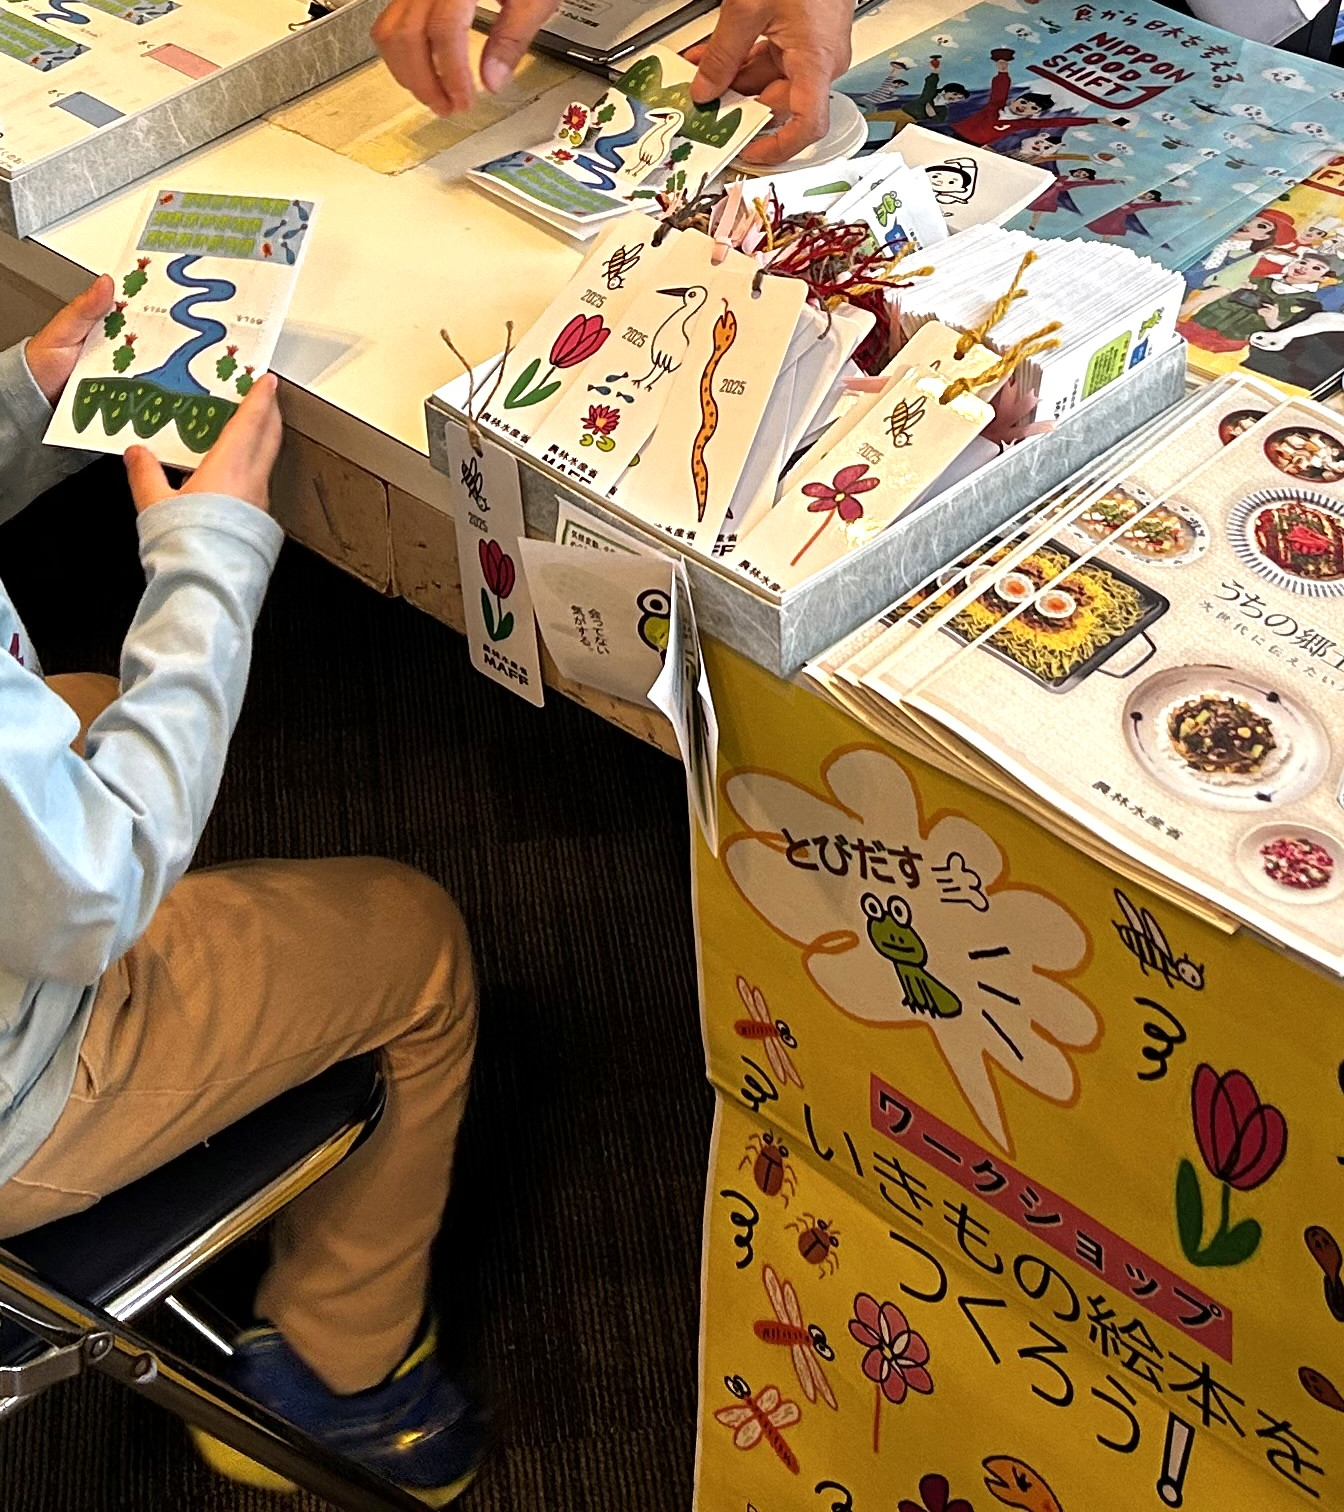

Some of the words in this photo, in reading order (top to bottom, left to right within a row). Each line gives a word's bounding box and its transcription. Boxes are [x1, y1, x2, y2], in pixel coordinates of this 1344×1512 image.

[1064, 43, 1142, 82] FOOD
[1072, 3, 1244, 89] 食から日本を考える。
[1087, 32, 1195, 84] NIPPON
[1043, 55, 1132, 96] SHIFT
[581, 289, 605, 309] 2025
[621, 326, 649, 349] 2025
[719, 378, 745, 396] 2025
[858, 441, 884, 466] 2025
[1091, 780, 1183, 840] 農林水産省
[780, 828, 924, 891] とびだす
[876, 1088, 1224, 1331] ワークショップ
[804, 1103, 1325, 1499] いきもの絵本を
[889, 1230, 1196, 1509] つくろう!
